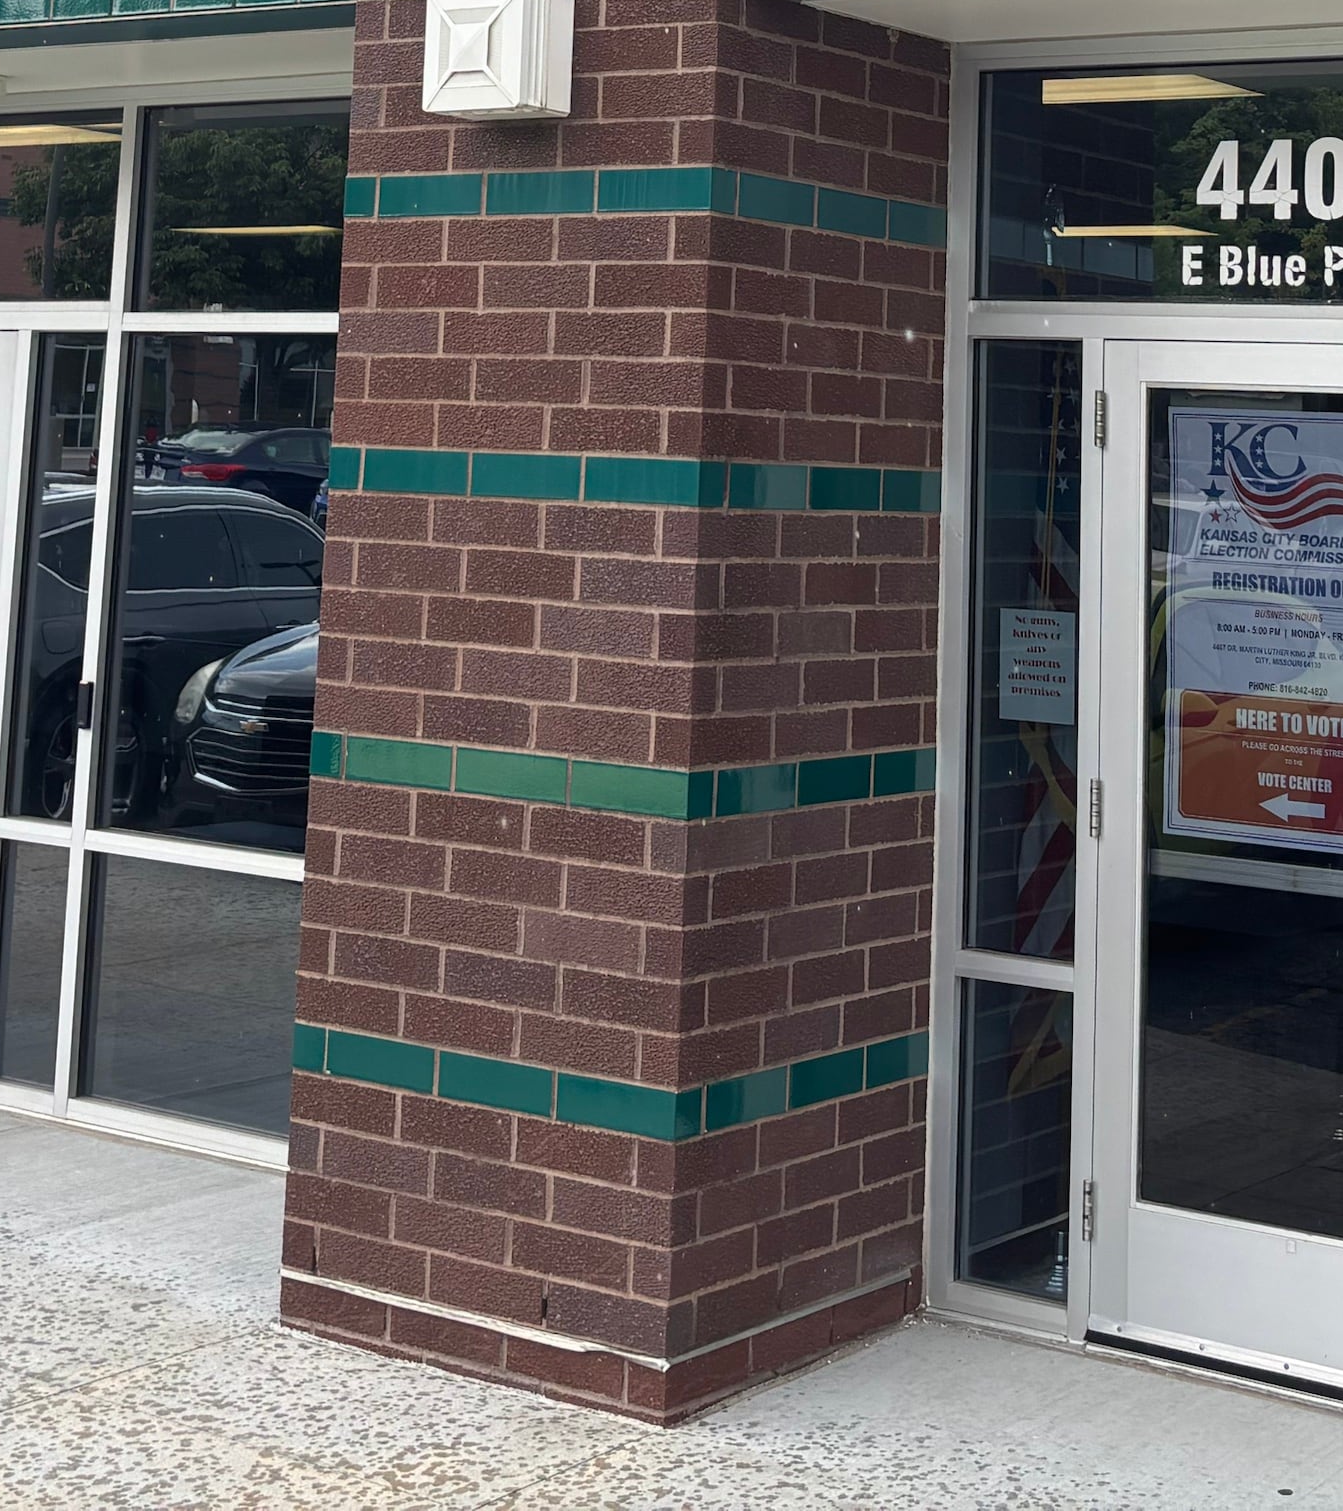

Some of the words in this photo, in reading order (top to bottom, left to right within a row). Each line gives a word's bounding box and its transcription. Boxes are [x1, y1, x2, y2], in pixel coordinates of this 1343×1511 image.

[1182, 245, 1203, 286] E
[1219, 245, 1306, 286] Blue
[1207, 422, 1307, 480] KC
[1200, 528, 1258, 544] KANSAS
[1263, 532, 1295, 546] CITY
[1200, 544, 1269, 560] ELECTION
[1212, 571, 1326, 598] REGISTRATION
[1254, 609, 1294, 621] BUSINESS
[1295, 613, 1323, 623] HOURS
[1012, 629, 1048, 640] knives
[1234, 625, 1246, 634] AM
[1269, 627, 1281, 636] PM
[1291, 629, 1326, 640] MONDAY
[1013, 658, 1061, 669] weapons
[1011, 686, 1061, 697] premises
[1248, 682, 1278, 692] PHONE:
[1236, 708, 1277, 732] HERE
[1281, 712, 1303, 734] TO
[1242, 740, 1267, 750] PLEASE
[1280, 745, 1308, 754] ACROSS
[1310, 747, 1322, 756] THE
[1258, 772, 1286, 788] VOTE
[1289, 775, 1333, 793] CENTER
